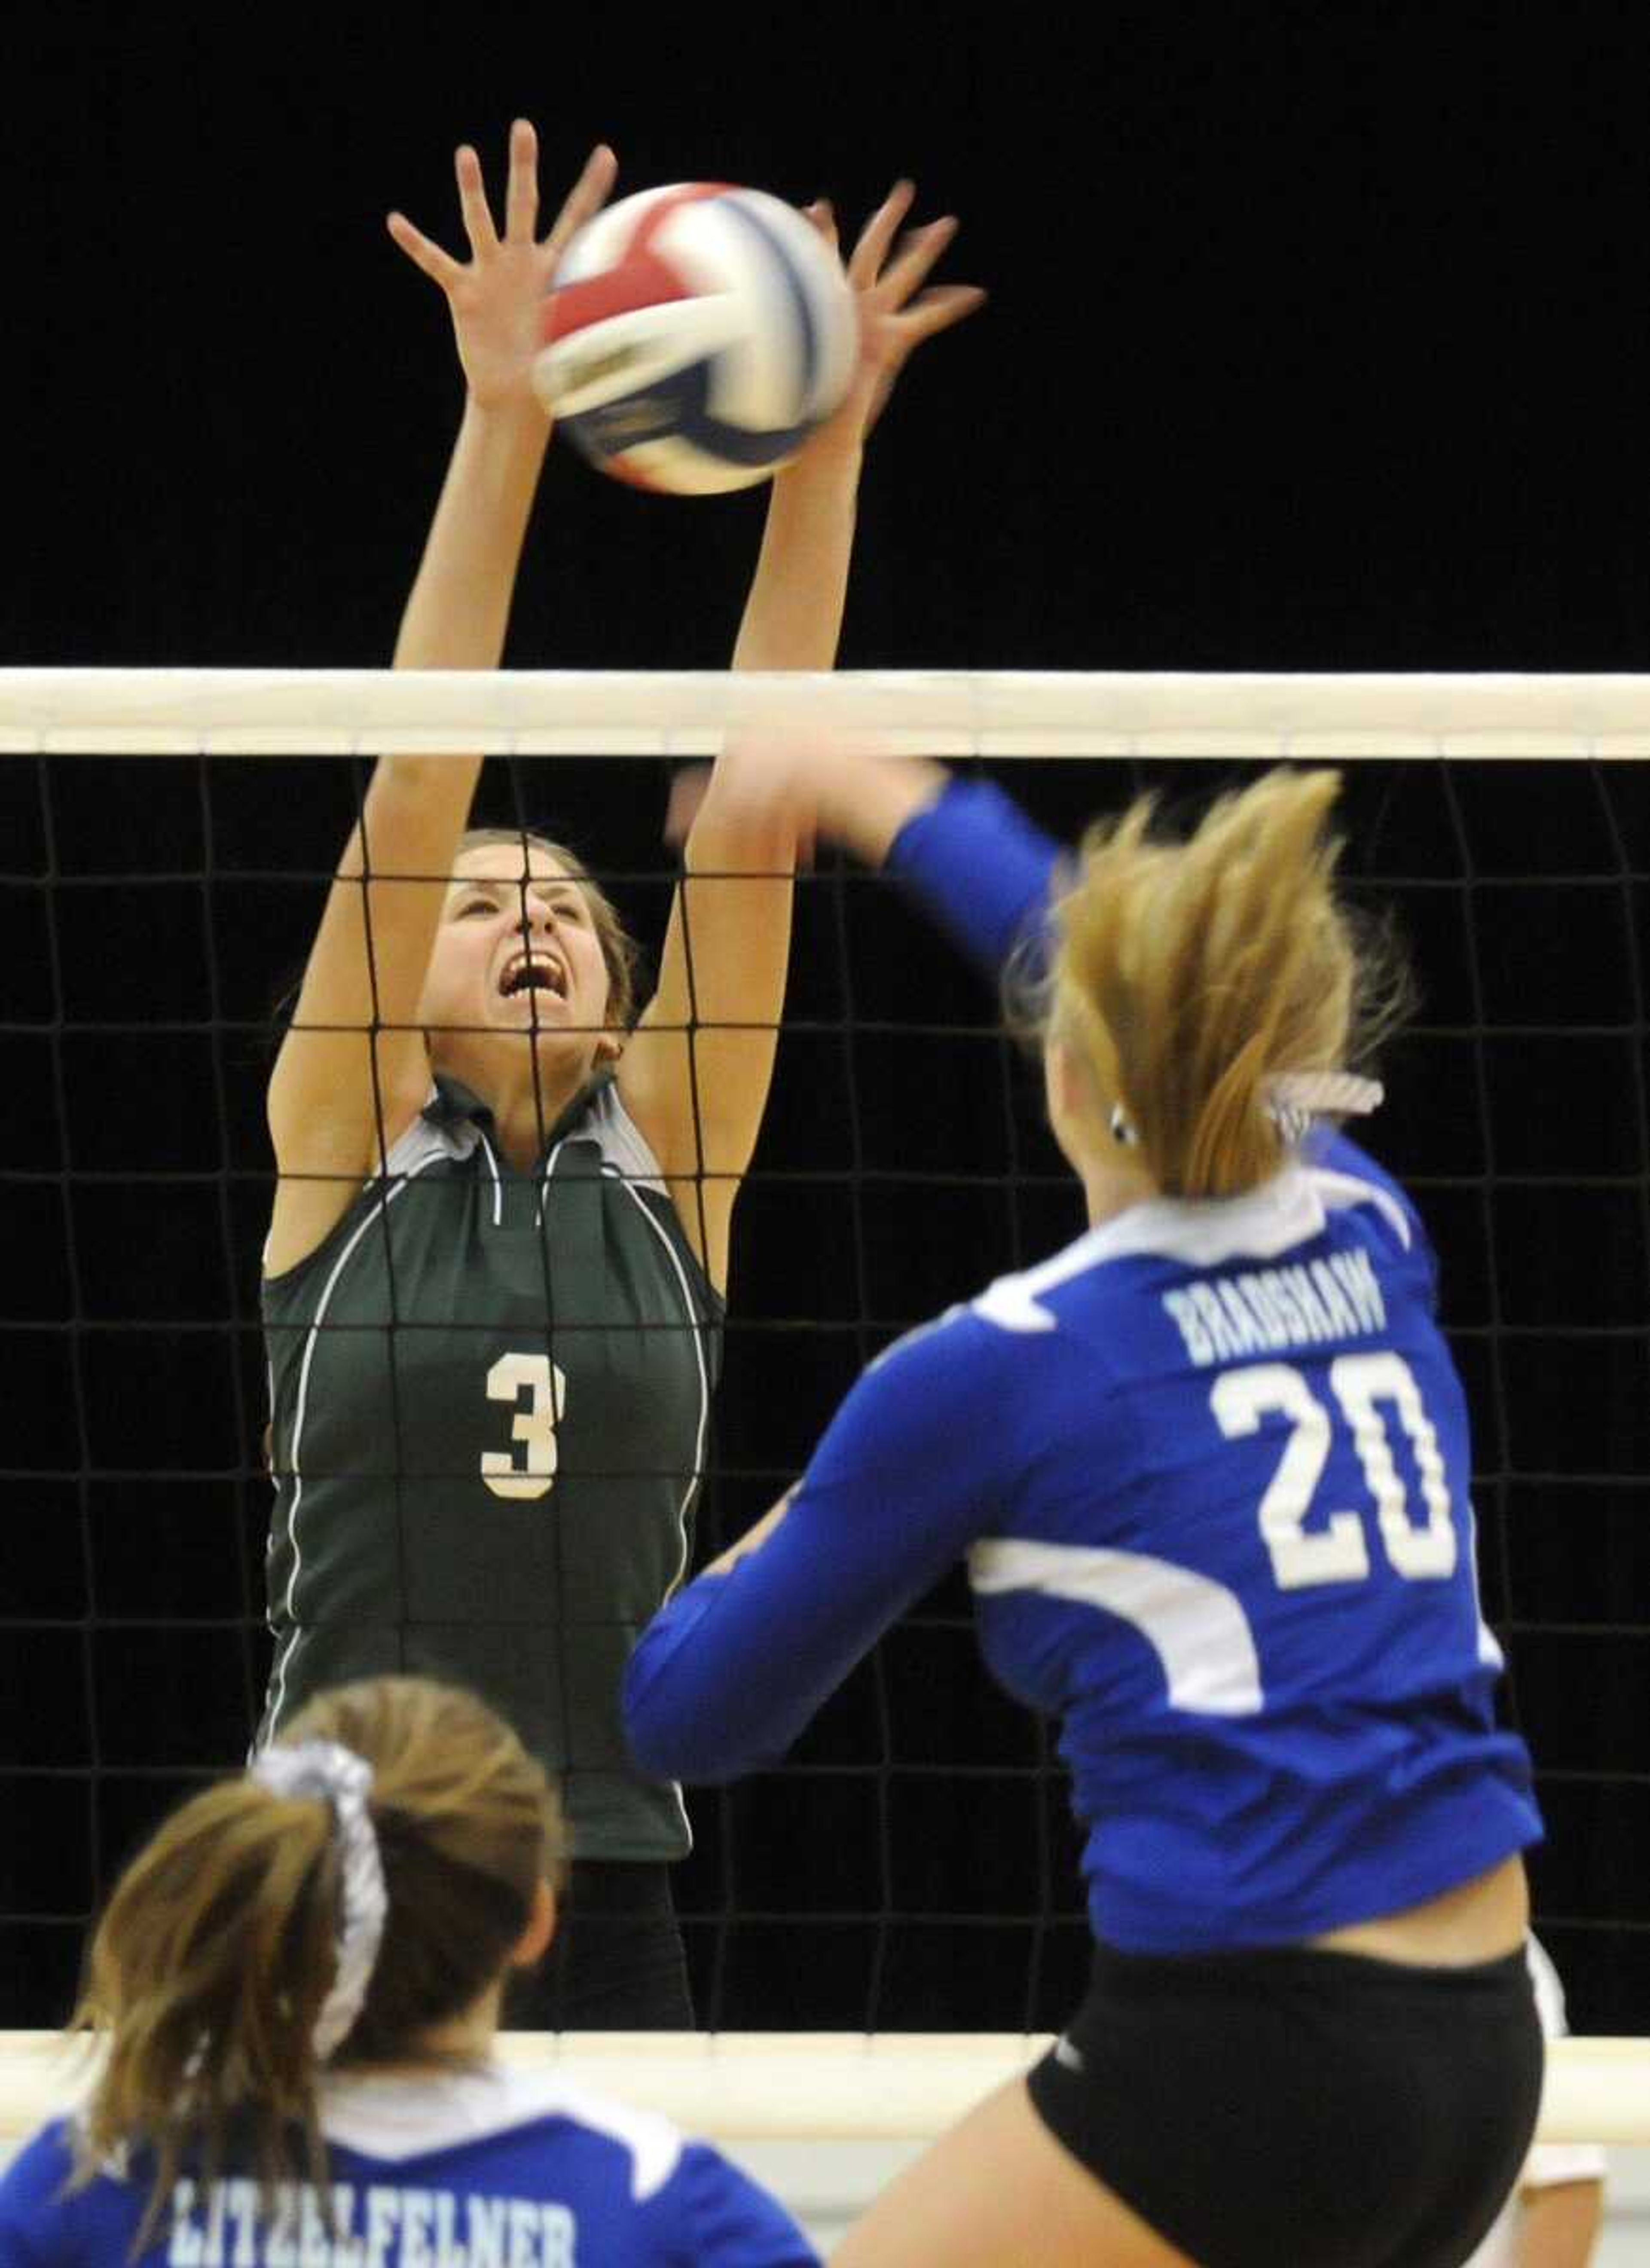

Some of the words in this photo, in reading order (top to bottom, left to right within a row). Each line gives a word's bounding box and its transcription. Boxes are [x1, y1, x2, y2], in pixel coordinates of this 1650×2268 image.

[1162, 1247, 1385, 1366] BRADSHAW
[481, 1353, 565, 1498] 3
[1210, 1351, 1457, 1590] 20
